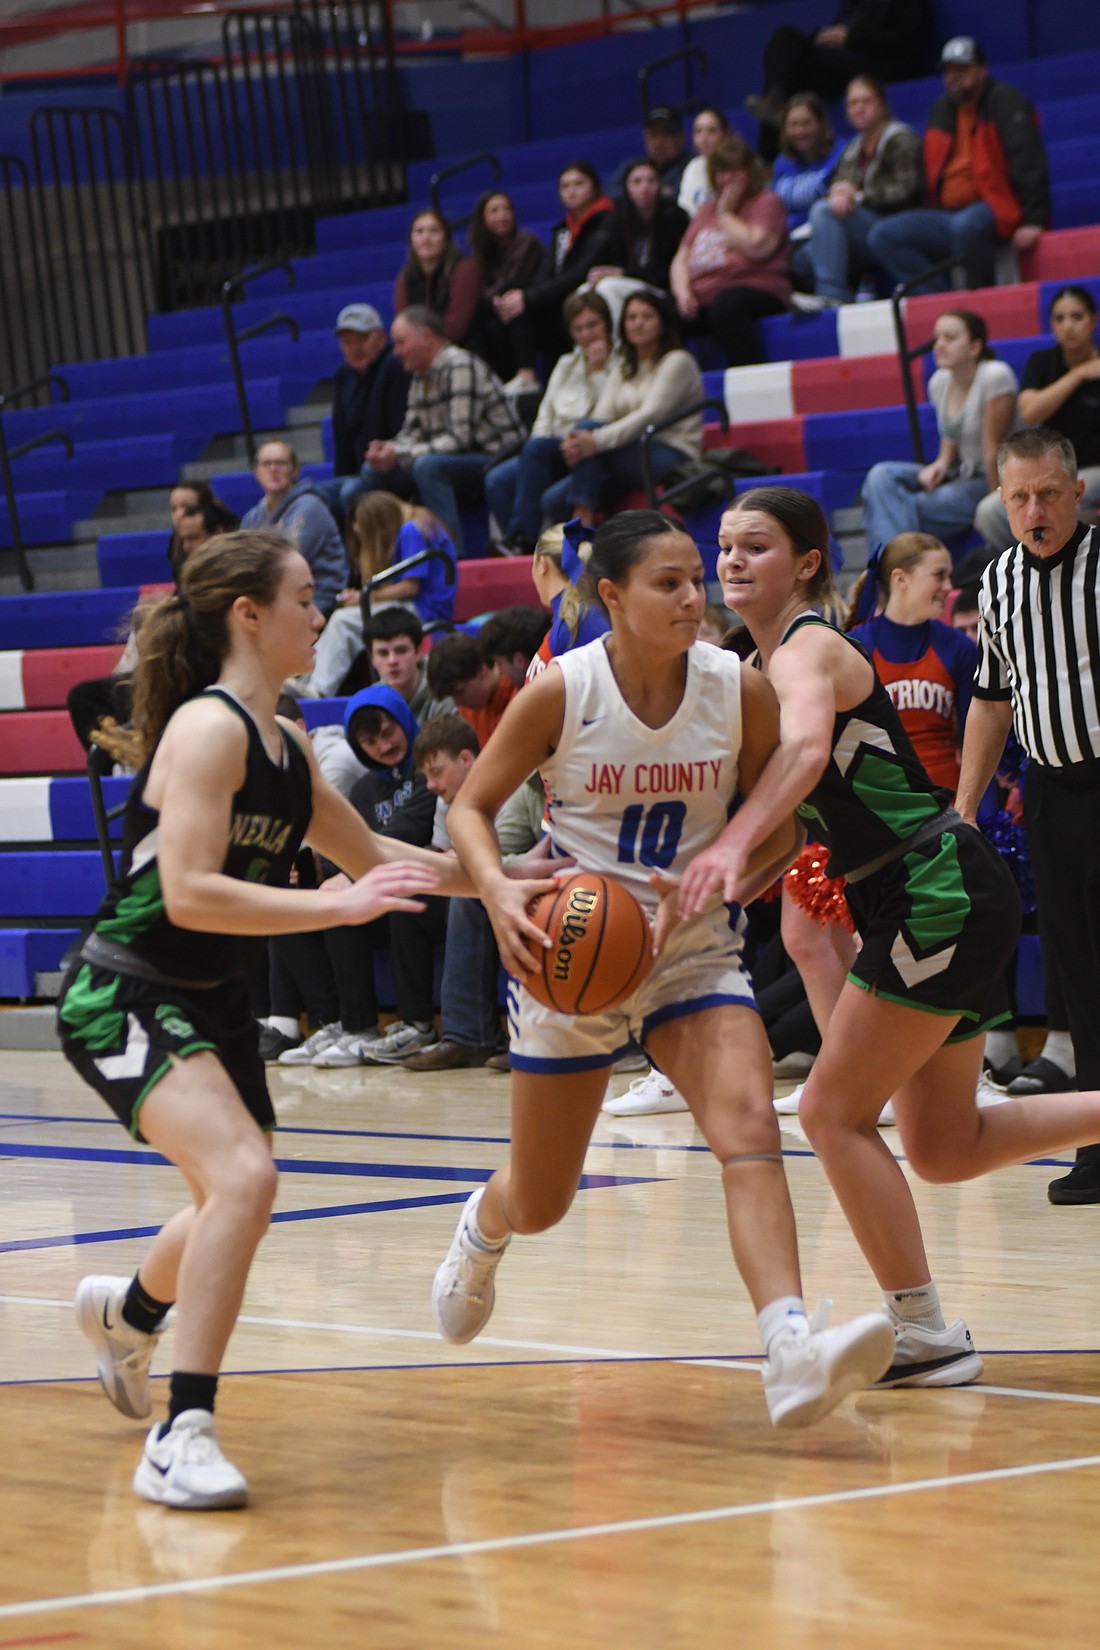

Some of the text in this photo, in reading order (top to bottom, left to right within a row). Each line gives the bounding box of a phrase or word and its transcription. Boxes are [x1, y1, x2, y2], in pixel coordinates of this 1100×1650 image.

[584, 758, 722, 795] JAY COUNTY
[617, 801, 687, 869] 10
[553, 887, 599, 982] Wilson
